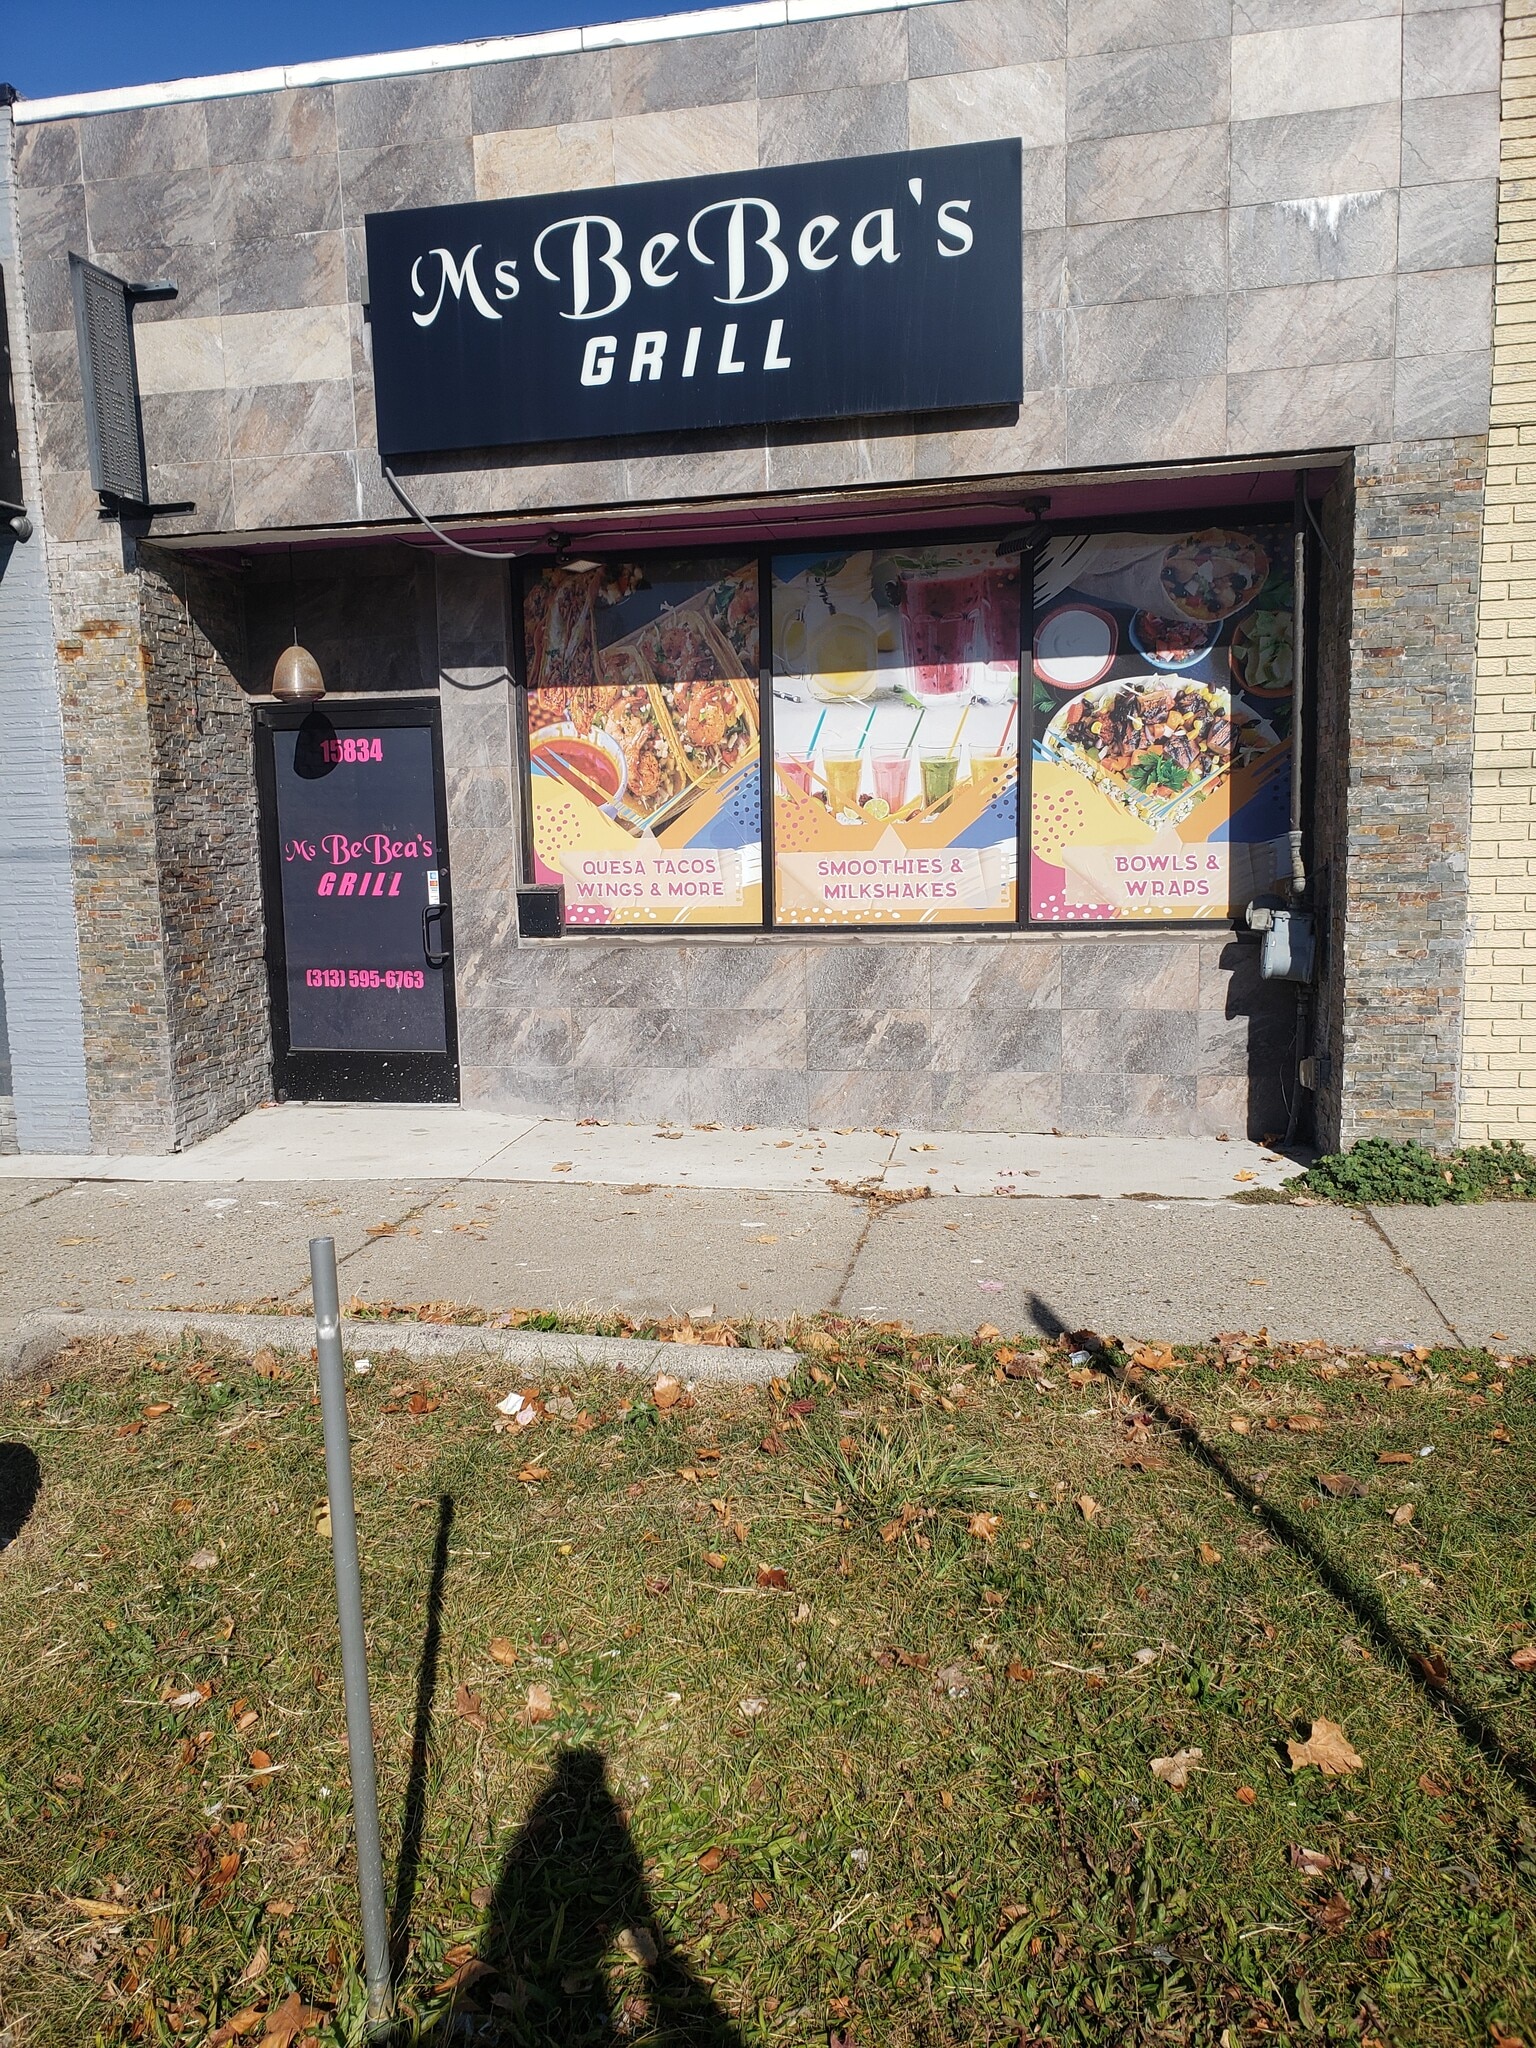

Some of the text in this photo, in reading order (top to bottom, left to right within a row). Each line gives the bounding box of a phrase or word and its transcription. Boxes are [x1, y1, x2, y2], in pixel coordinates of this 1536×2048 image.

[410, 177, 975, 328] Ms BeBea's
[580, 318, 791, 387] GRILL
[94, 294, 134, 481] OPEN
[320, 738, 383, 763] 15834
[285, 833, 433, 865] Ms BeBea's
[583, 859, 716, 876] QUESA TACOS
[817, 858, 963, 877] SMOOTHIES &
[1114, 854, 1220, 872] BOWLS &
[318, 872, 402, 896] GRILL
[576, 882, 725, 897] WINGS & MORE
[824, 882, 958, 899] MILKSHAKES
[1124, 879, 1210, 897] WRAPS
[306, 969, 424, 989] (313) 595-6763
